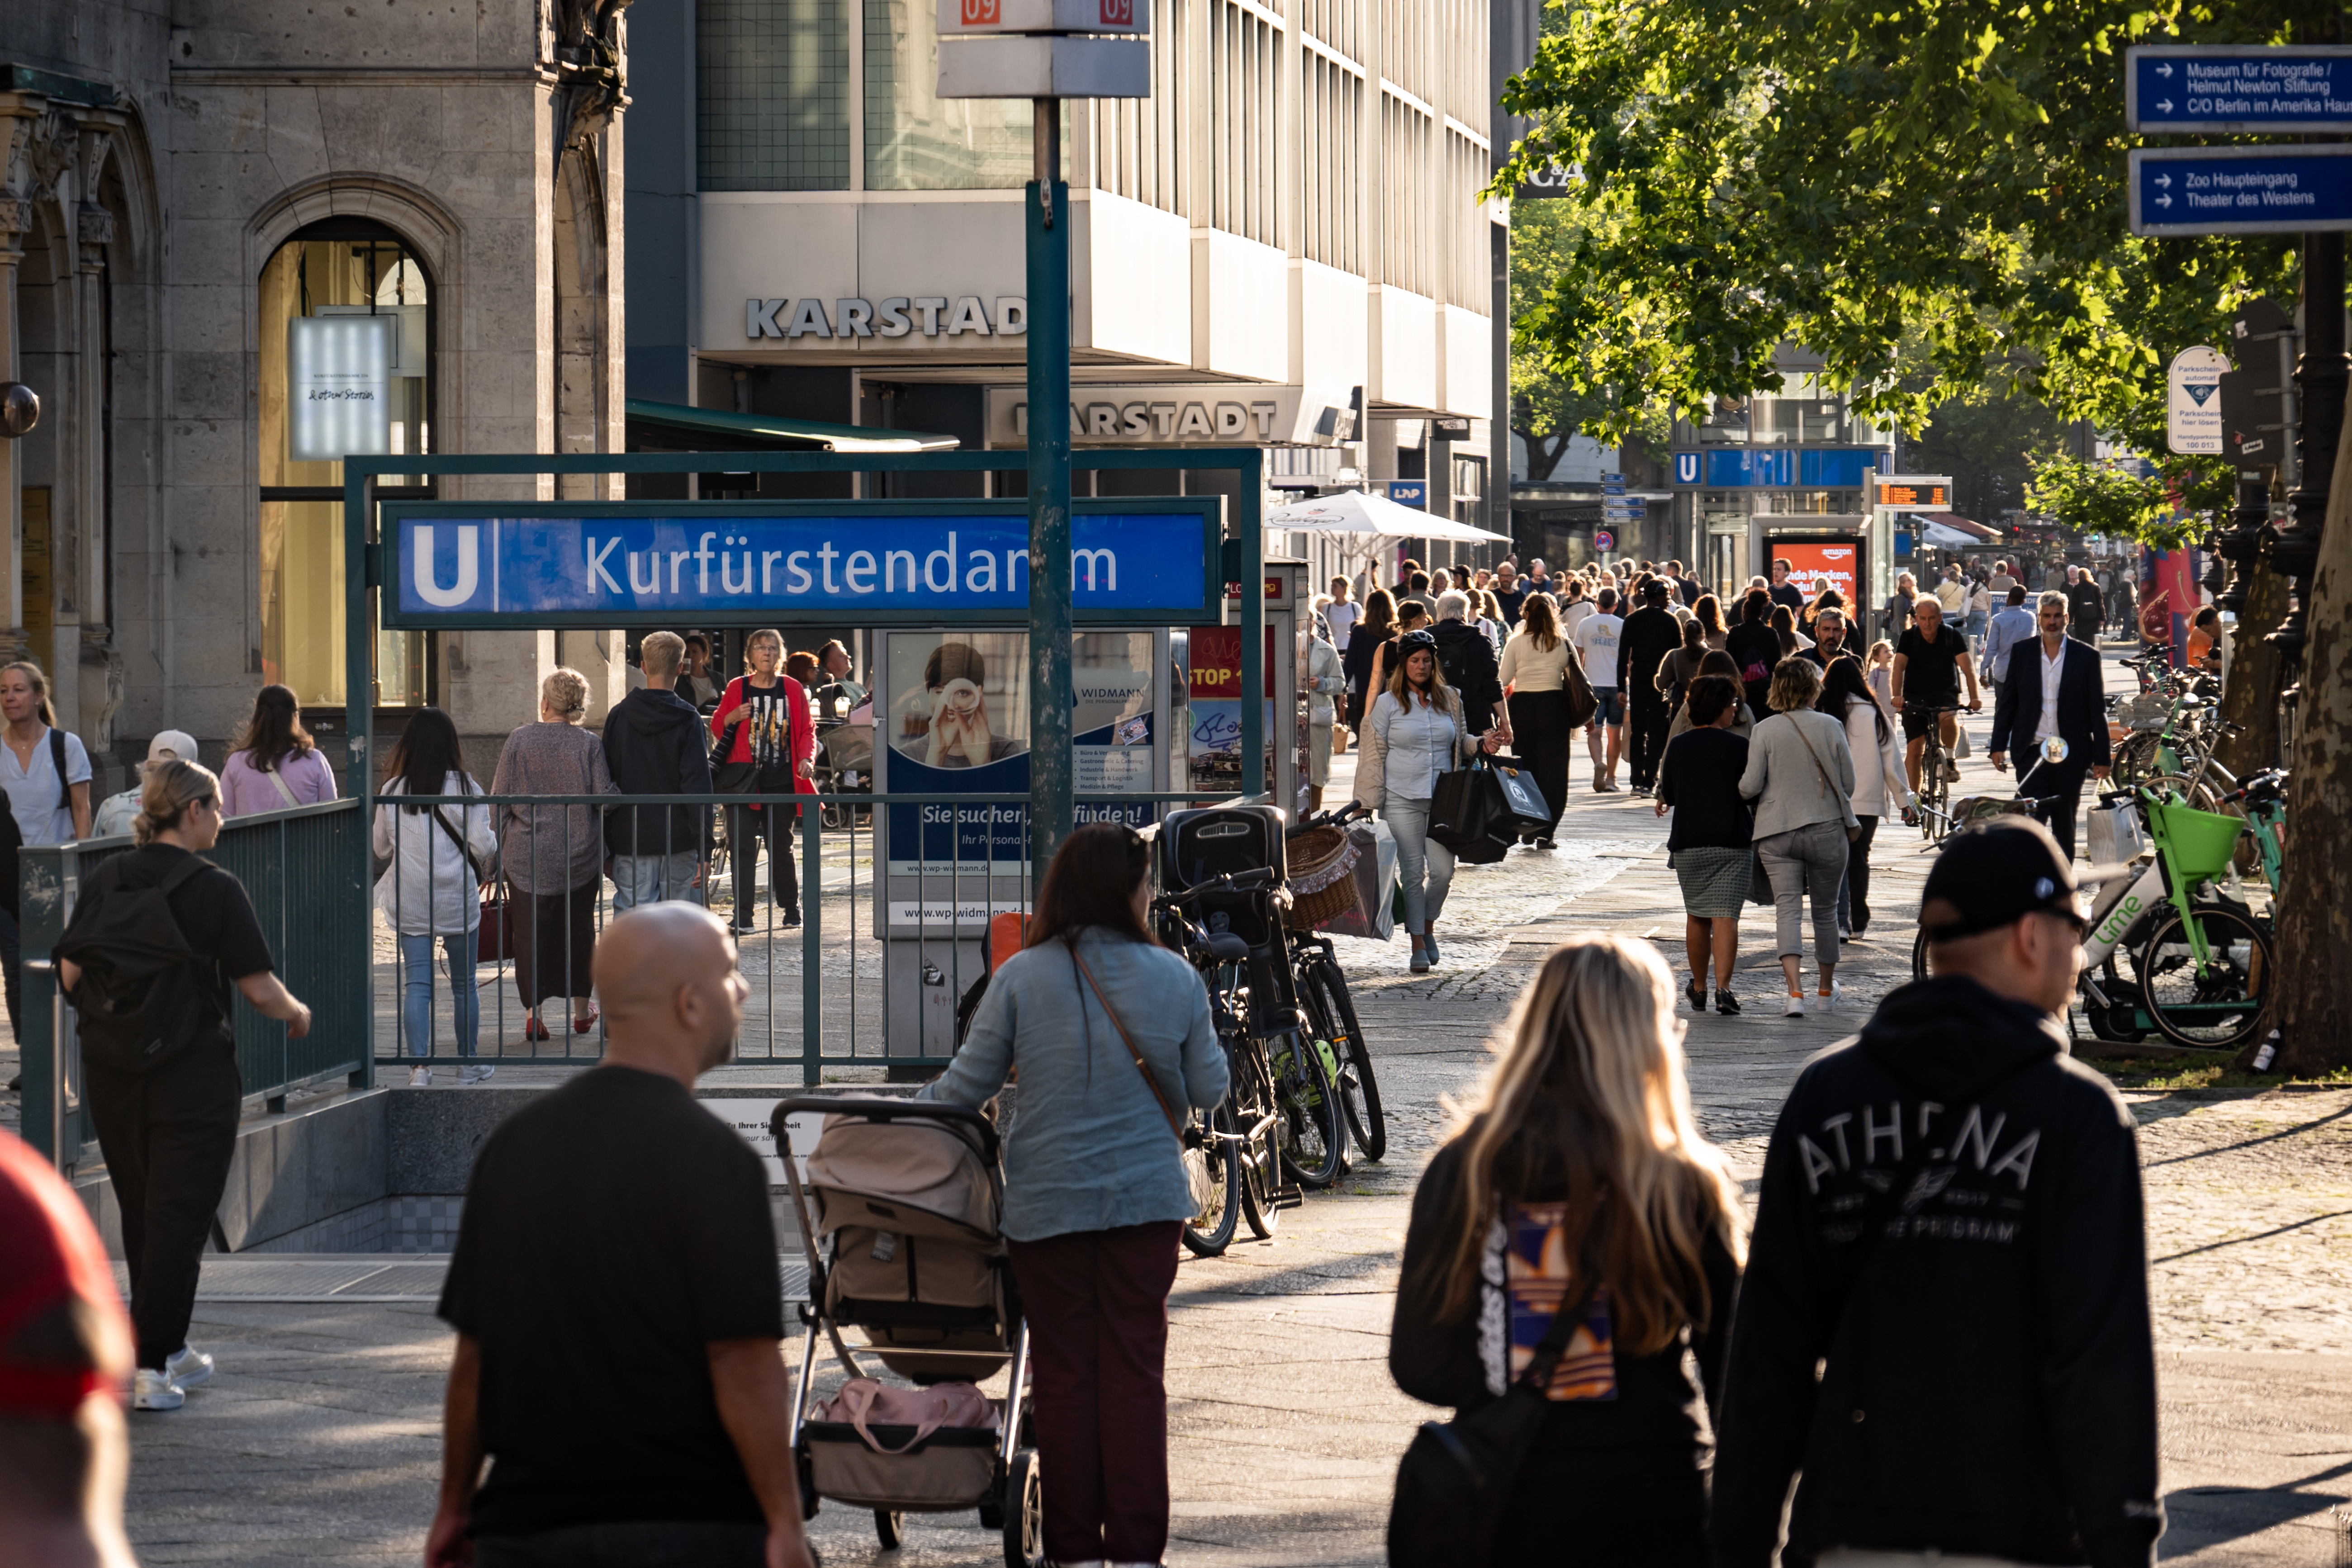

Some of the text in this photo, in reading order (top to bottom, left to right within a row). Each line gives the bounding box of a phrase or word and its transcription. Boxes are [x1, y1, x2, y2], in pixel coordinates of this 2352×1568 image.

[2187, 62, 2239, 78] Museum
[2243, 62, 2260, 78] für
[2262, 62, 2324, 80] Fotografie
[2187, 77, 2330, 96] Helmut Newton Stiftung
[2187, 98, 2212, 114] C/O
[2215, 98, 2250, 113] Berlin
[2254, 98, 2268, 113] im
[2271, 98, 2321, 113] Amerika
[2186, 172, 2298, 190] Zoo Haupteingang
[2186, 191, 2315, 208] Theater des Westens
[746, 296, 1027, 338] KARSTAD
[308, 388, 374, 401] & other Stories
[1680, 455, 1696, 481] U
[414, 526, 478, 607] U
[1788, 569, 1807, 580] nde
[1081, 688, 1144, 697] WIDMANN
[924, 805, 952, 823] Sie
[1074, 805, 1142, 823] finden!
[962, 834, 1032, 844] Ihr Prsona-
